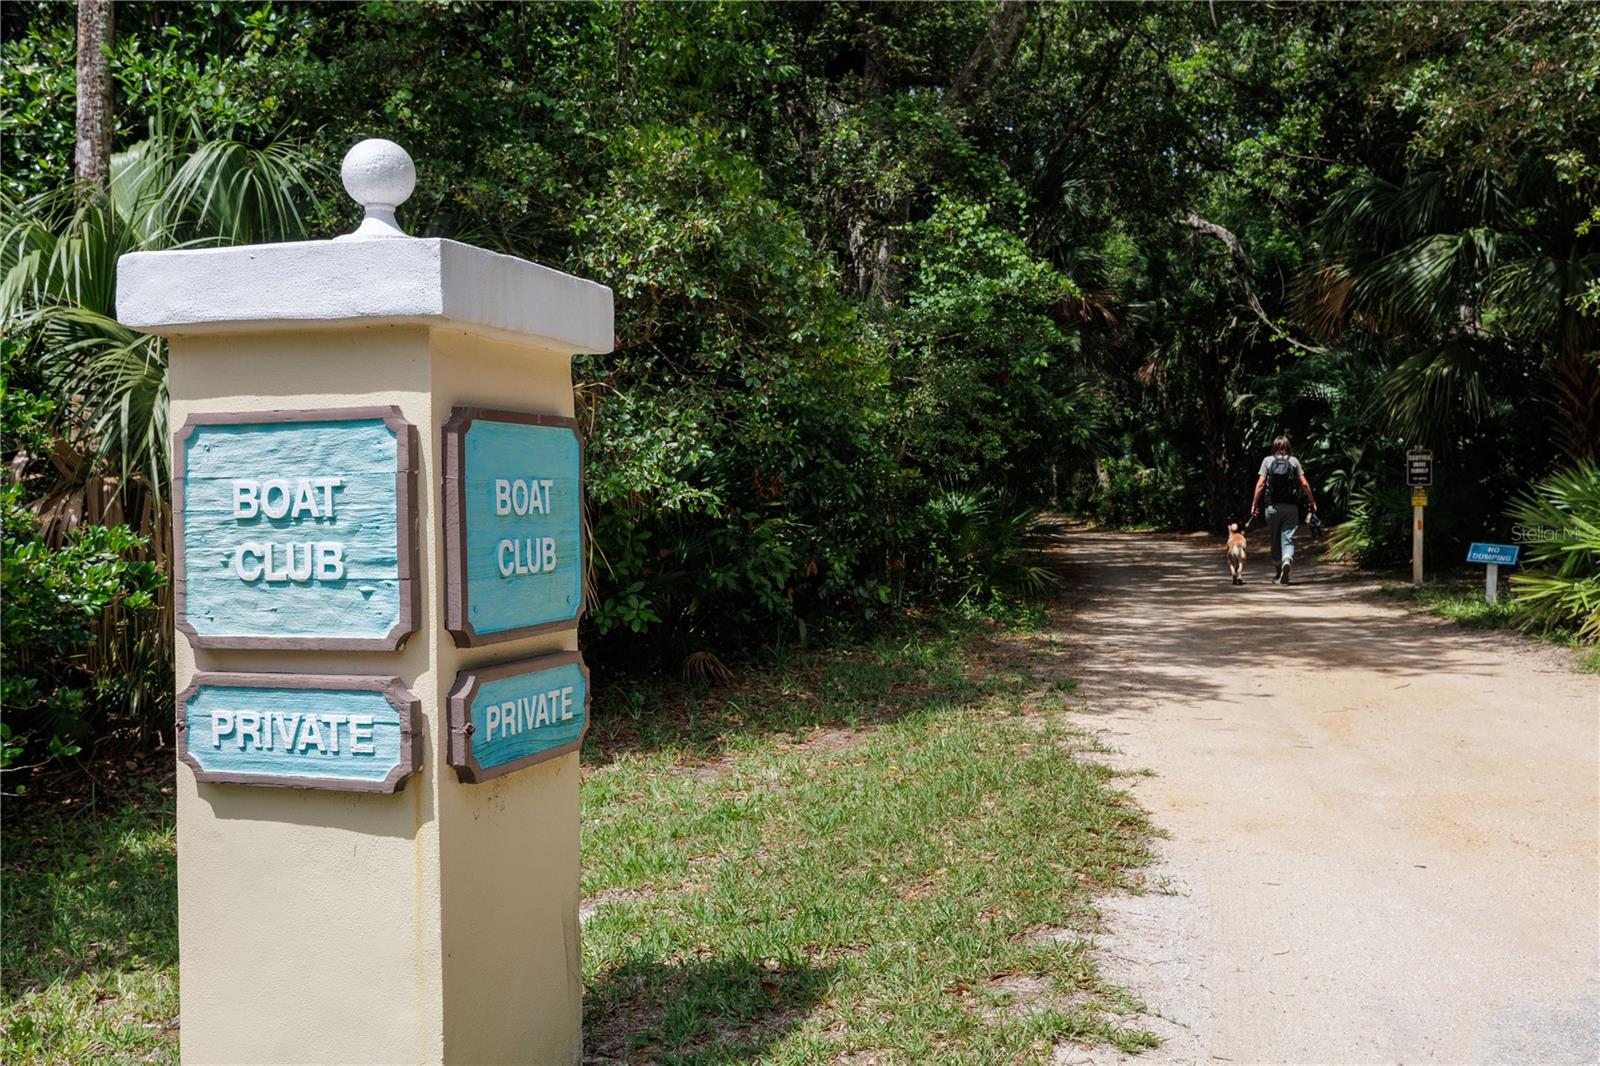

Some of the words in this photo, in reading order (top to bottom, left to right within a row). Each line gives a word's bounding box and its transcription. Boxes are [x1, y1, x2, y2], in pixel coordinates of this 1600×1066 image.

[232, 478, 341, 520] BOAT
[495, 478, 554, 516] BOAT
[234, 541, 345, 583] CLUB
[497, 537, 558, 578] CLUB
[1472, 552, 1512, 562] DUMPING
[211, 709, 374, 753] PRIVATE
[486, 686, 573, 742] PRIVATE
